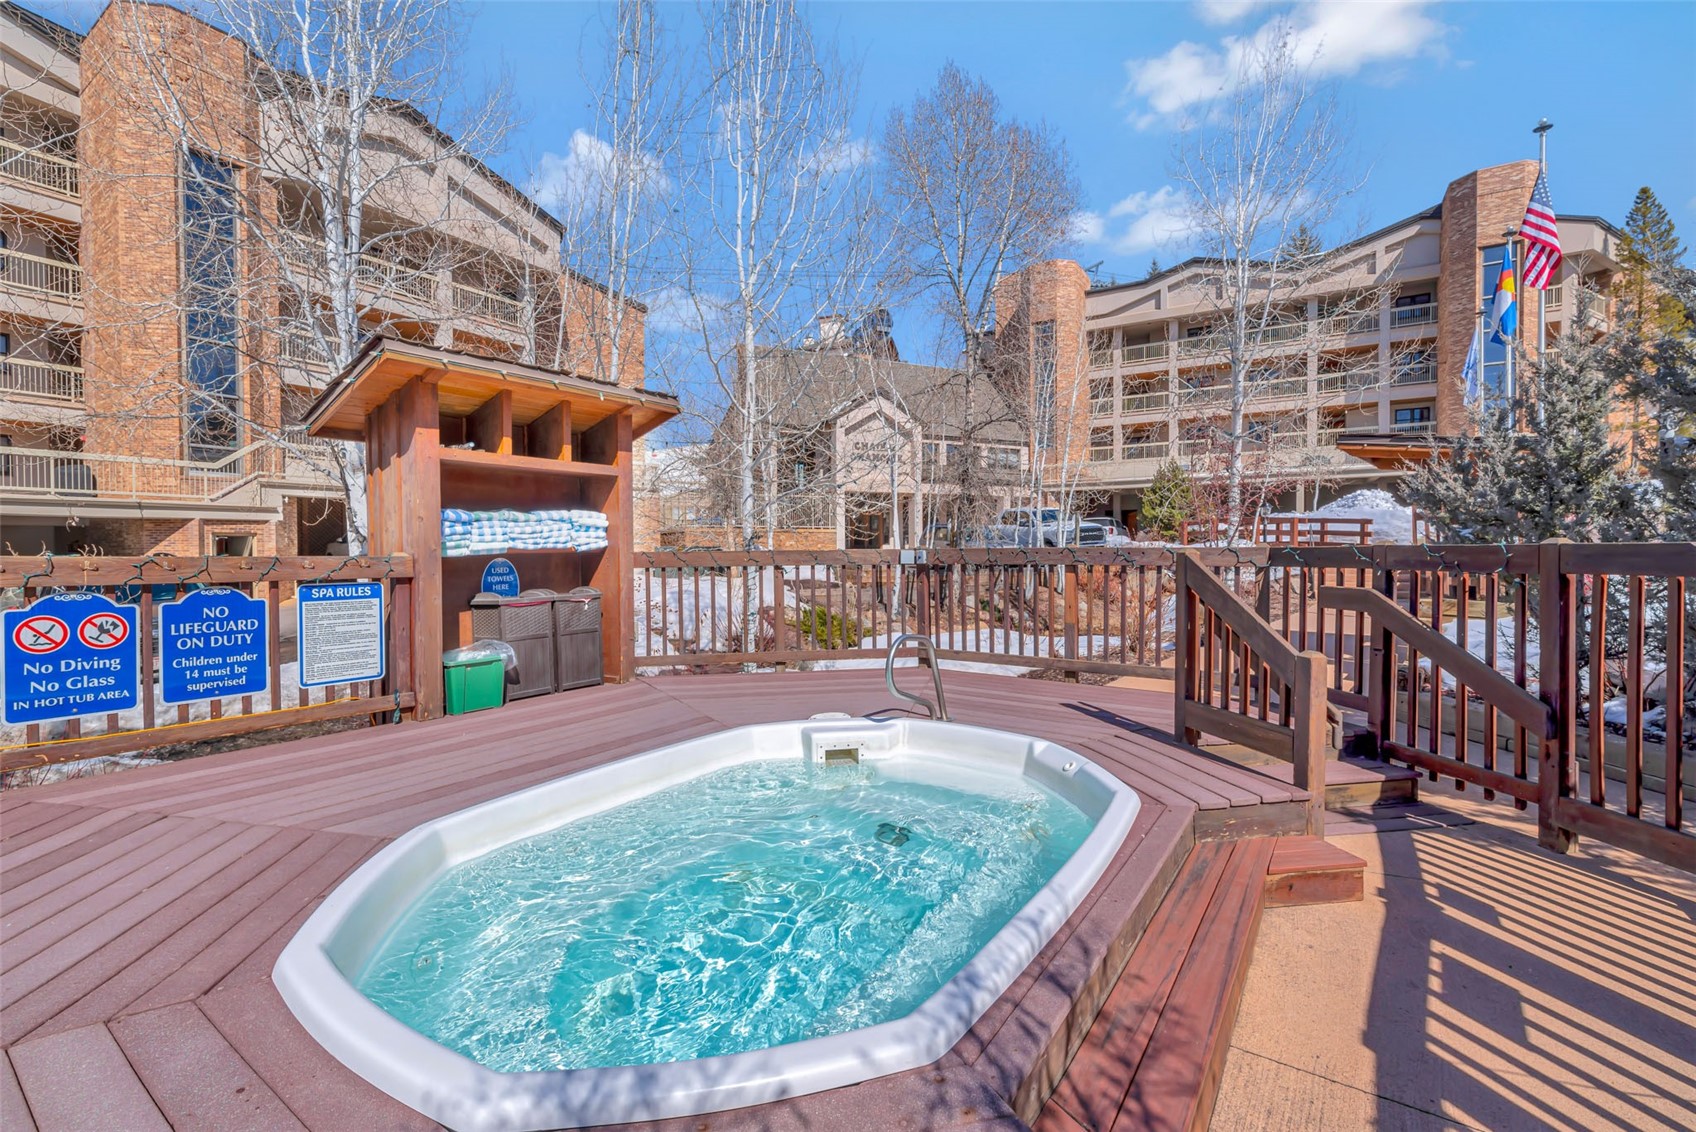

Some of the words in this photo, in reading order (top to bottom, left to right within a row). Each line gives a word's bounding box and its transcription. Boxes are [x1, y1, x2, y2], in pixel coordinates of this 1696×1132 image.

[487, 575, 514, 583] TOWELS
[311, 587, 334, 599] SPA
[336, 586, 371, 597] RULES
[203, 606, 229, 619] NO
[170, 619, 259, 636] LIFEGUARD
[176, 637, 204, 650] ON
[210, 633, 254, 648] DUTY
[23, 662, 53, 676] No
[60, 656, 122, 671] Diving
[172, 656, 222, 669] Children
[226, 652, 258, 663] under
[185, 669, 199, 679] 14
[203, 667, 231, 677] must
[234, 664, 248, 674] be
[30, 680, 59, 694] No
[65, 675, 115, 690] Glass
[186, 675, 246, 692] supervised
[13, 701, 29, 711] IN
[34, 696, 65, 708] HOT
[68, 693, 94, 704] TUB
[97, 689, 130, 701] AREA
